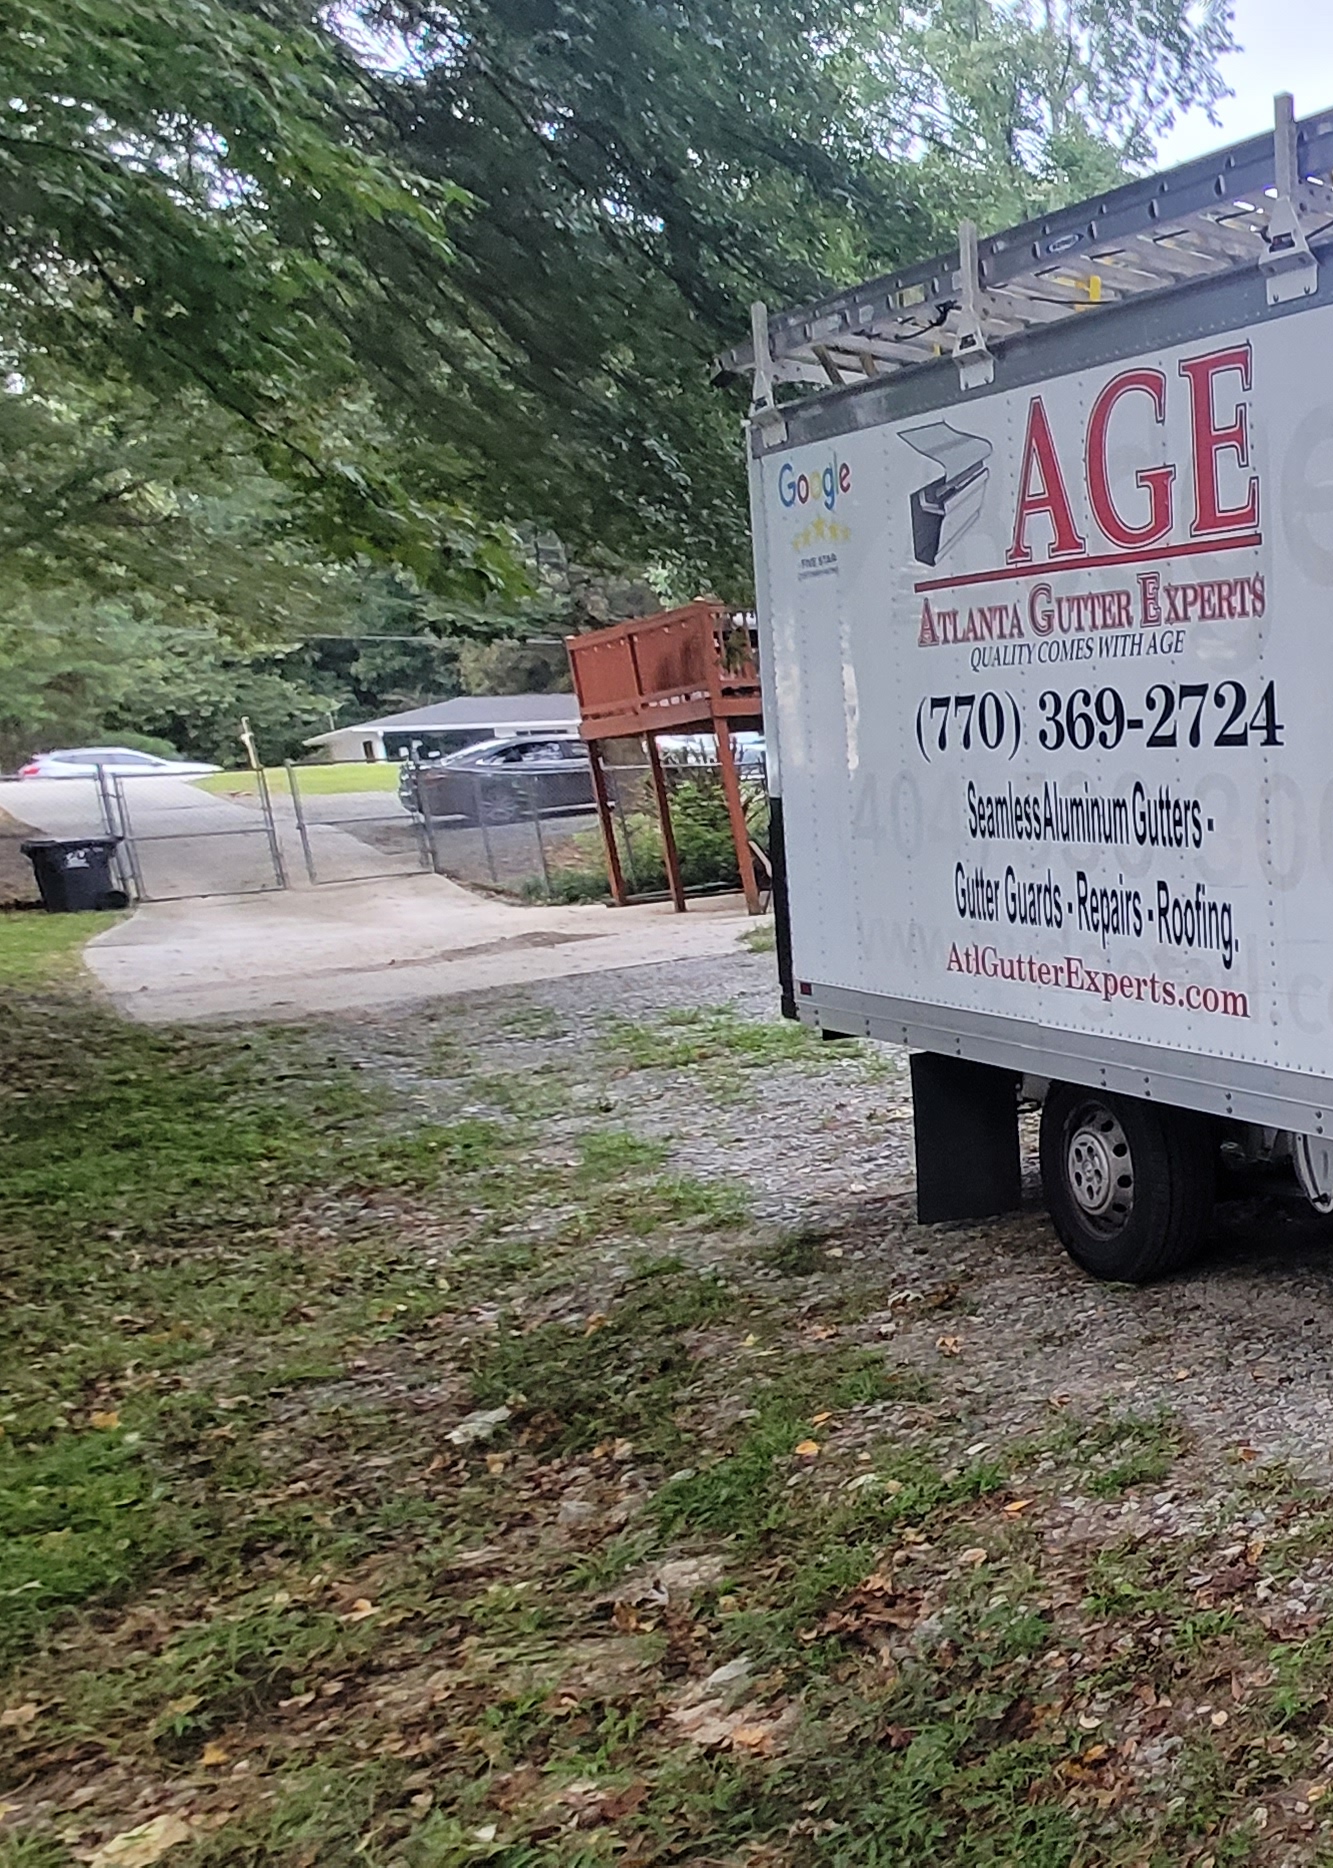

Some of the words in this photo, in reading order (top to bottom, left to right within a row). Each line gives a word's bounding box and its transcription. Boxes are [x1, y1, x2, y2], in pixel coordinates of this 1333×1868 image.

[778, 450, 851, 511] Google
[1006, 338, 1259, 565] AGE
[918, 597, 1024, 648] ATLANTA
[1028, 582, 1133, 636] GUTTER
[1137, 571, 1266, 629] EXPERTS
[970, 641, 1036, 673] QUALITY
[1037, 637, 1093, 664] COMES
[1097, 632, 1144, 659] WITH
[1147, 629, 1187, 656] AGE
[916, 689, 1021, 763] (770)
[1038, 680, 1284, 751] 369-2724
[967, 780, 1042, 841] Seamless
[1043, 781, 1130, 846] Aluminum
[1132, 781, 1203, 850] Gutters
[955, 861, 1000, 923] Gutter
[1004, 865, 1064, 929] Guards
[1076, 870, 1143, 950] Repairs
[1156, 879, 1240, 970] Roofing.
[946, 941, 1251, 1019] AtlGutterExperts.com
